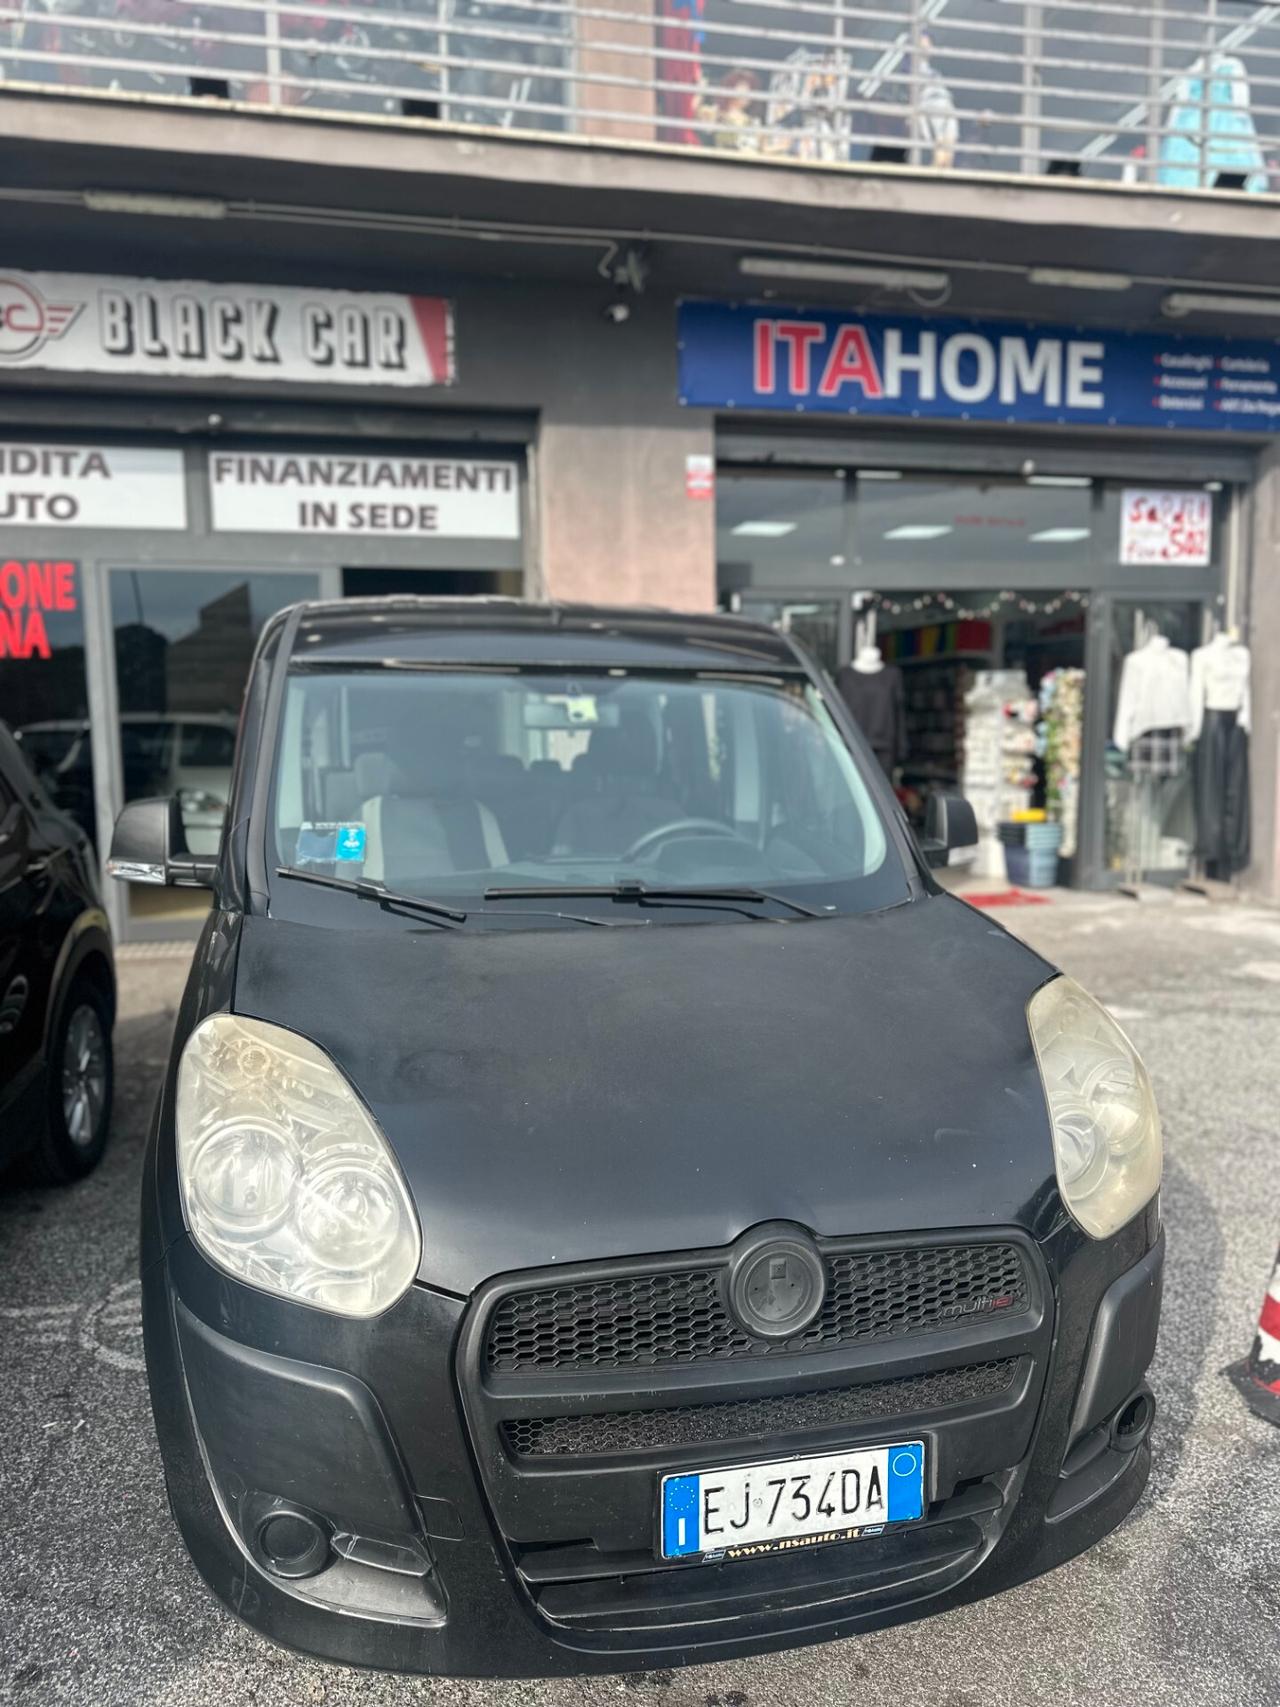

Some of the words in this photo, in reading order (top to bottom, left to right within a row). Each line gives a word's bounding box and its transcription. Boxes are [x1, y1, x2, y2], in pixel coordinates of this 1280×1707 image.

[99, 288, 282, 364] BLACK
[302, 302, 409, 371] CAR
[753, 318, 1105, 410] ITAHOME
[0, 449, 111, 478] DITA
[214, 457, 513, 493] FINANZIAMENTI
[300, 503, 338, 529] IN
[348, 503, 439, 531] SEDE
[727, 1527, 861, 1559] www.nsauto.it
